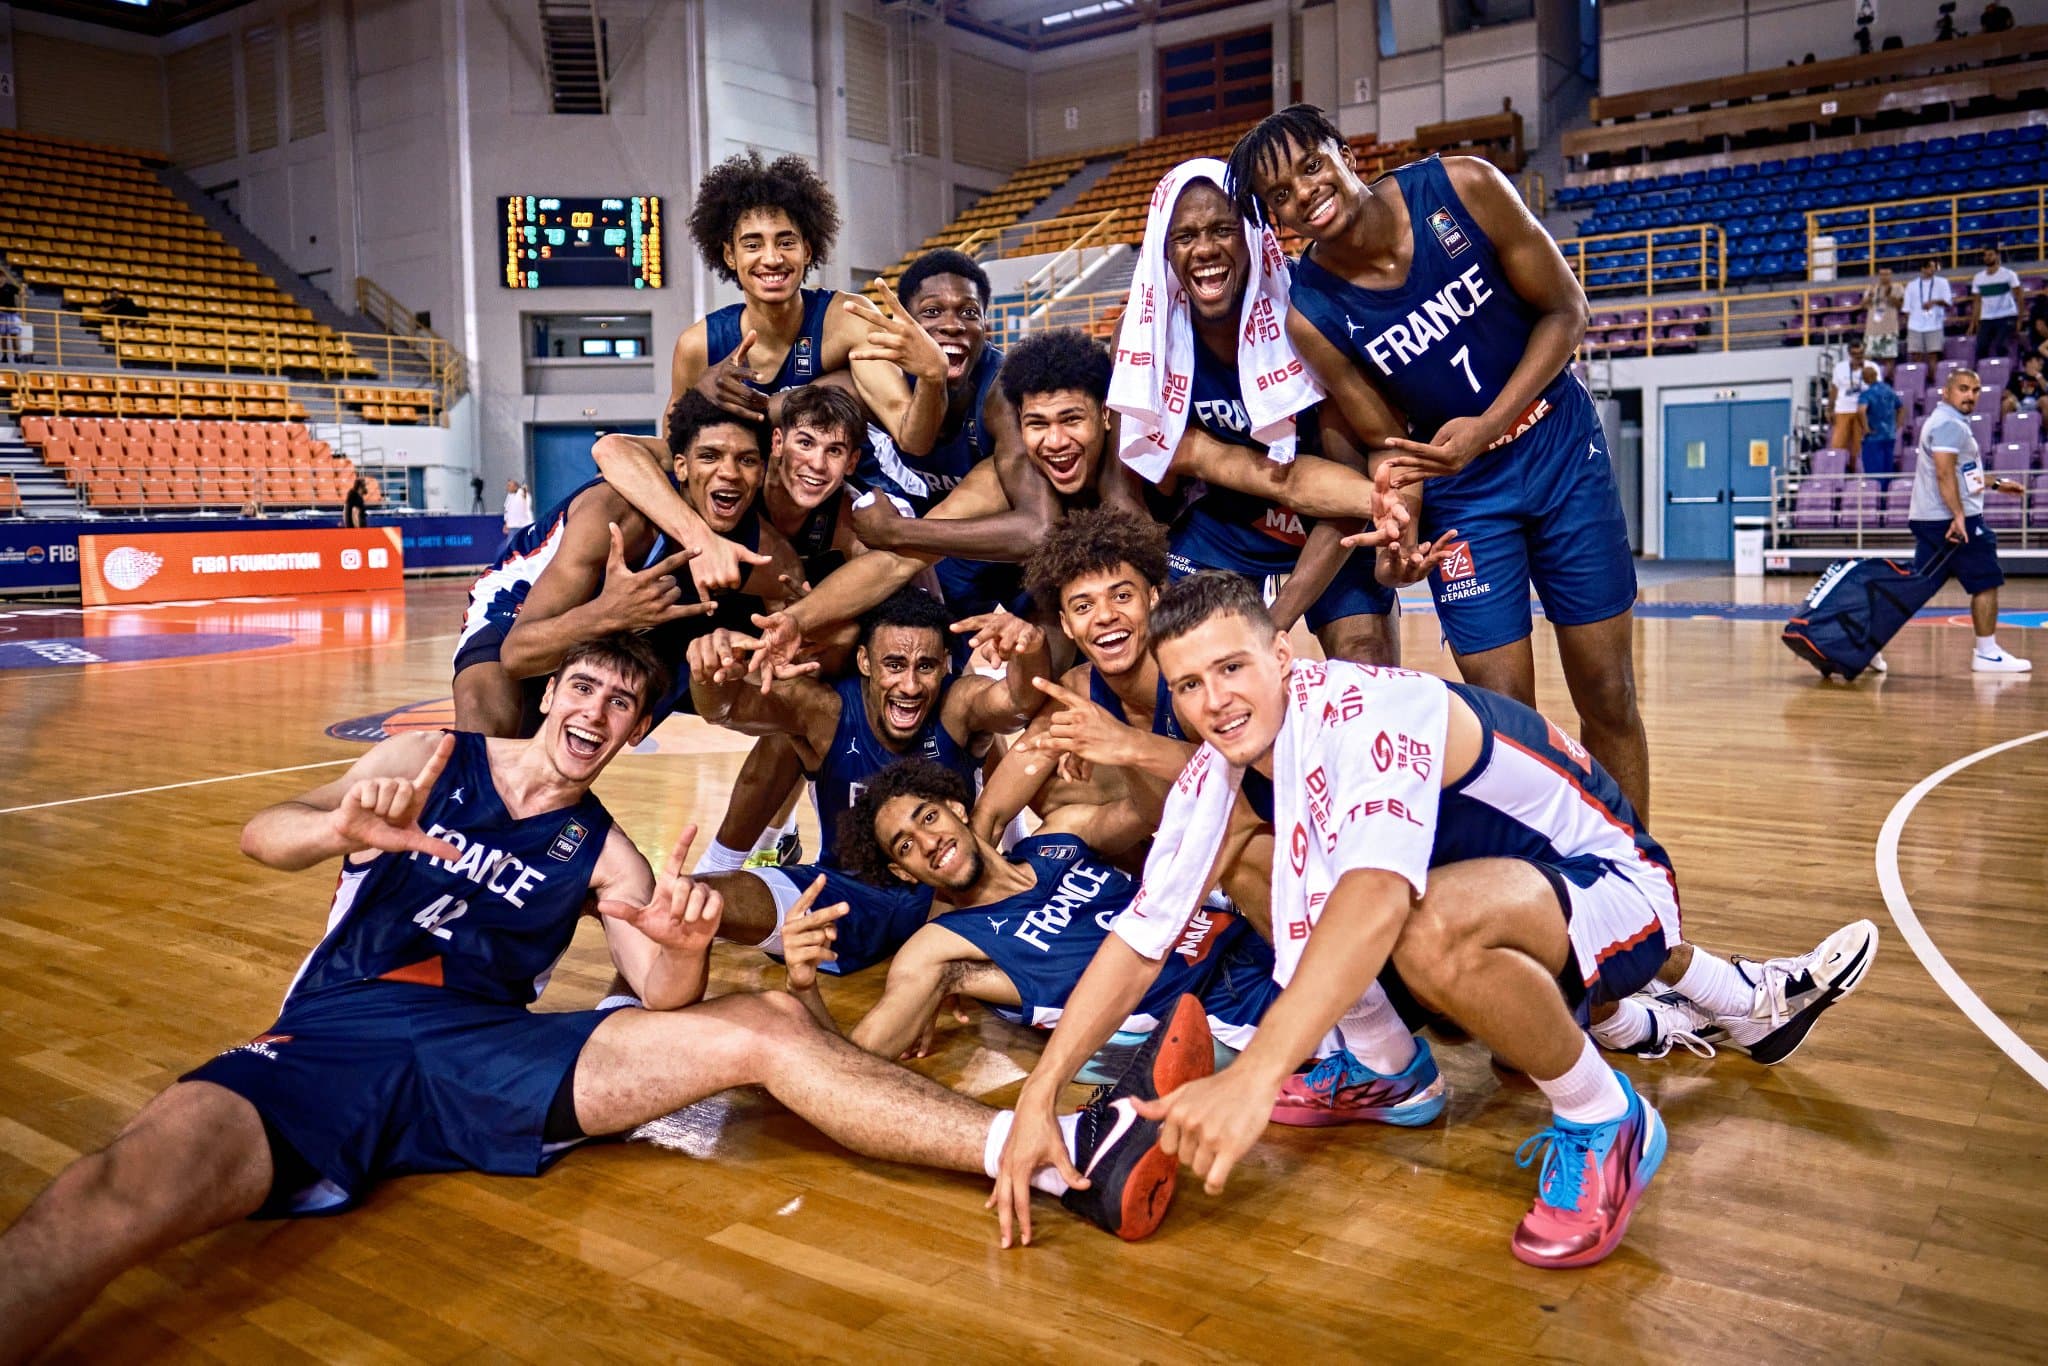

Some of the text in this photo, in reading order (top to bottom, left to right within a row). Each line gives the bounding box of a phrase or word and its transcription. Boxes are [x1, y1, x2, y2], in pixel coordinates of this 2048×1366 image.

[1444, 231, 1462, 247] FIBA
[1364, 262, 1494, 377] FRANCE
[1450, 344, 1482, 394] 7
[1168, 373, 1188, 415] BIO
[192, 552, 321, 574] FIBA FOUNDATION
[1446, 577, 1478, 592] CAISSE
[1440, 583, 1491, 603] D'EPARGNE
[408, 822, 548, 909] FRANCE
[556, 840, 574, 853] FIBA
[412, 893, 469, 941] 42
[1013, 857, 1112, 953] FRANCE
[1175, 910, 1214, 958] MAIF
